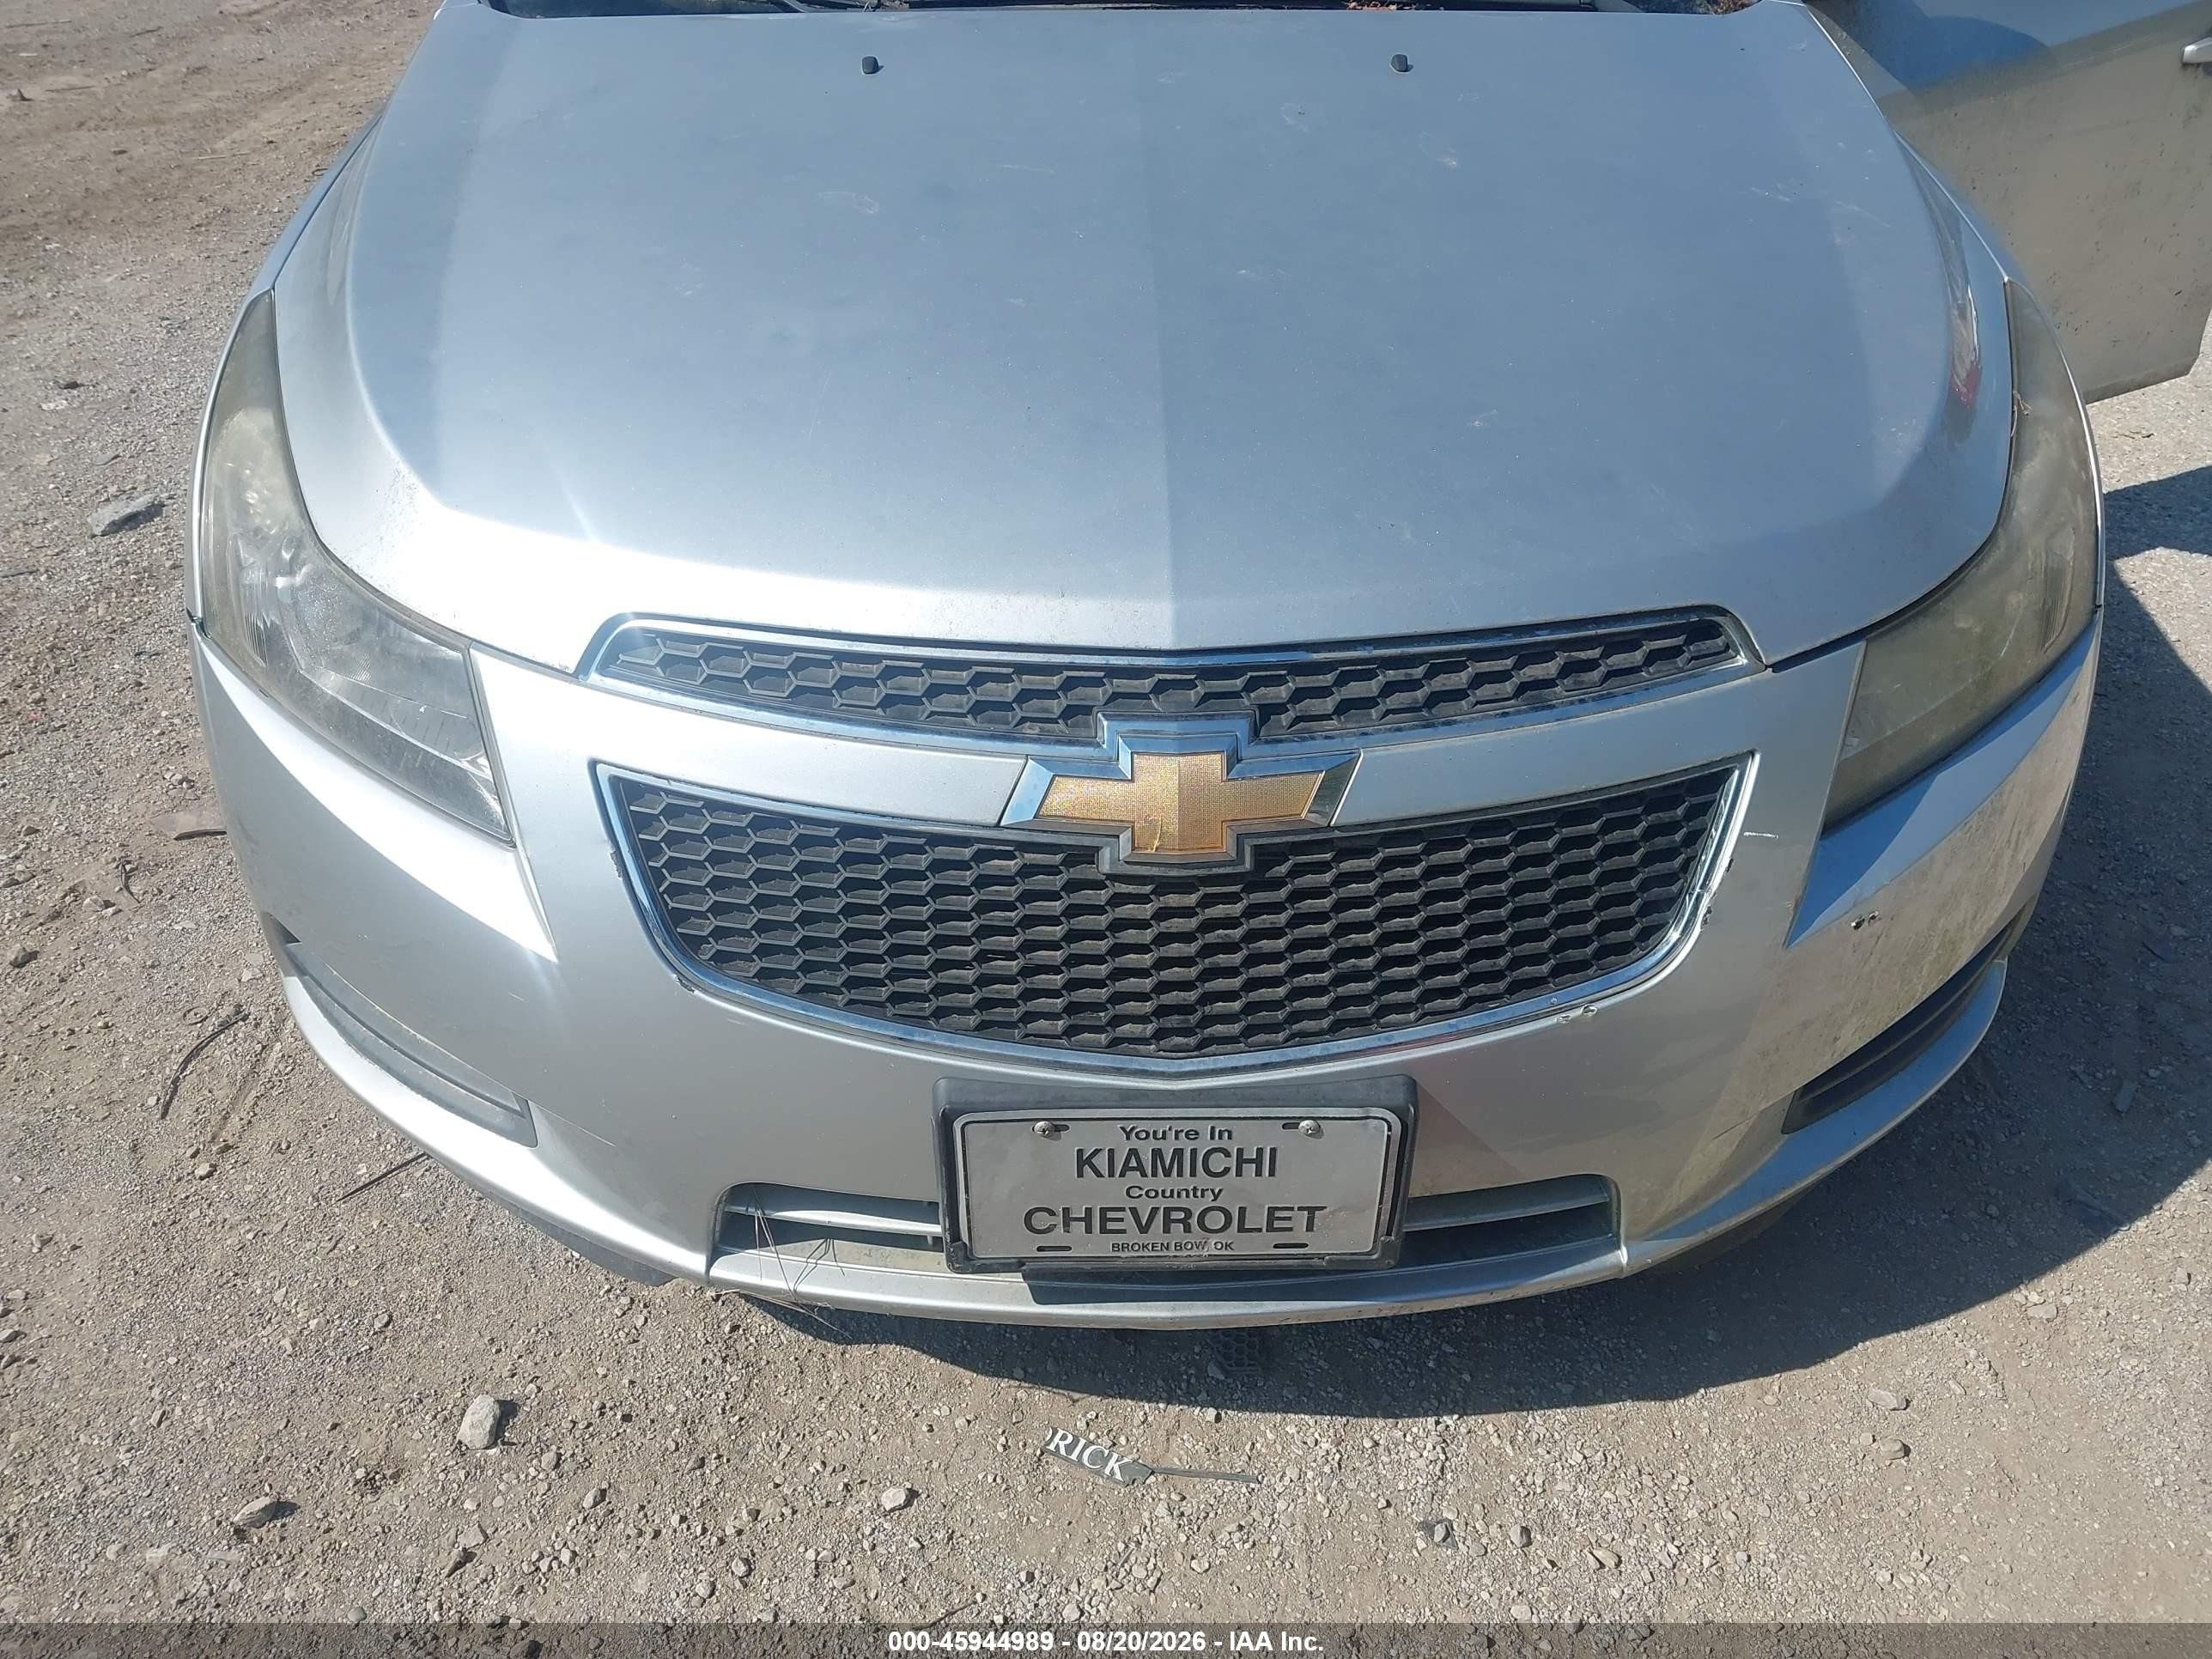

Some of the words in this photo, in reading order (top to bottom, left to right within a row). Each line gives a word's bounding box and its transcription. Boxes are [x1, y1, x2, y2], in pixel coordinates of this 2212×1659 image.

[1120, 1126, 1199, 1141] You're
[1208, 1126, 1232, 1140] In
[1076, 1146, 1277, 1178] KIAMICHI
[1125, 1185, 1223, 1201] Country
[1024, 1206, 1327, 1235] CHEVROLET
[1111, 1243, 1170, 1252] BROKEN
[1213, 1242, 1234, 1251] OK
